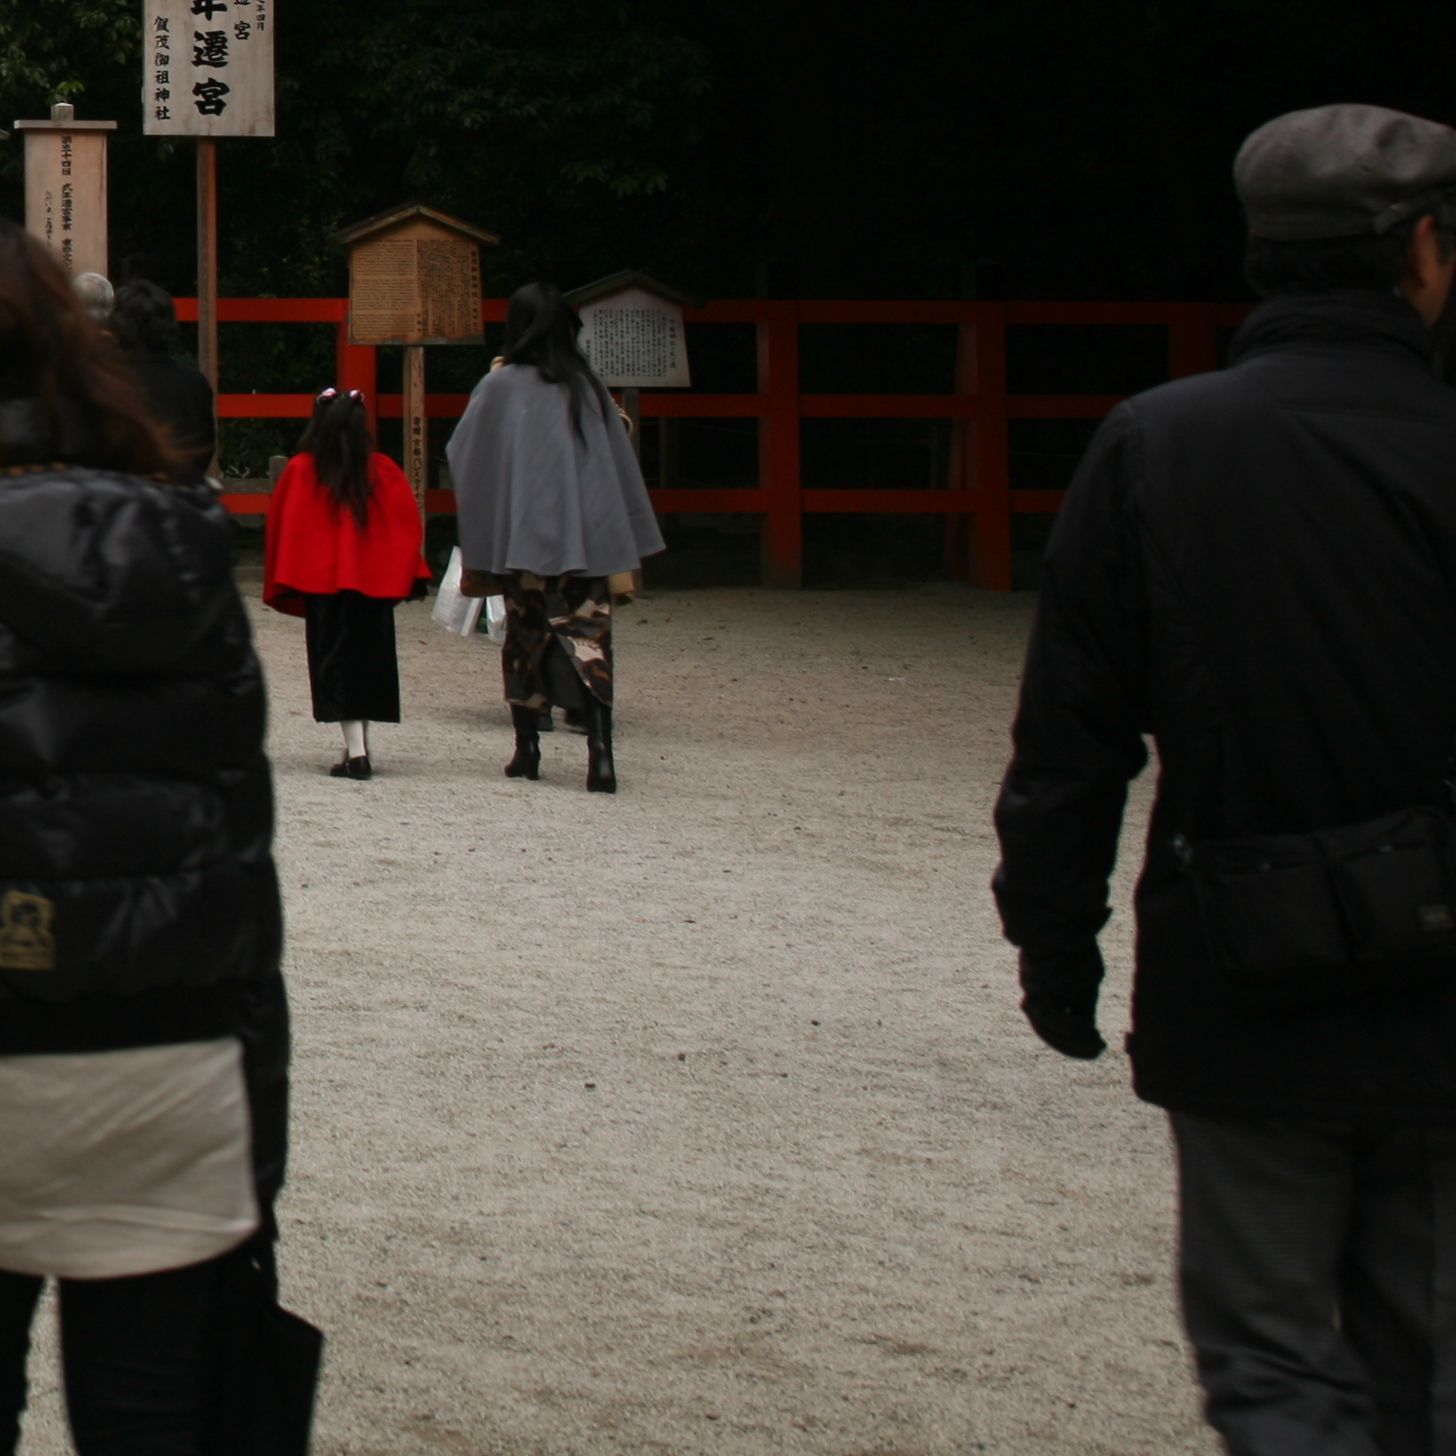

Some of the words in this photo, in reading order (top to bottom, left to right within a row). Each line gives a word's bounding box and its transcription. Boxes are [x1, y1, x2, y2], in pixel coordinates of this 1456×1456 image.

[154, 15, 171, 121] 賀茂御祖神社
